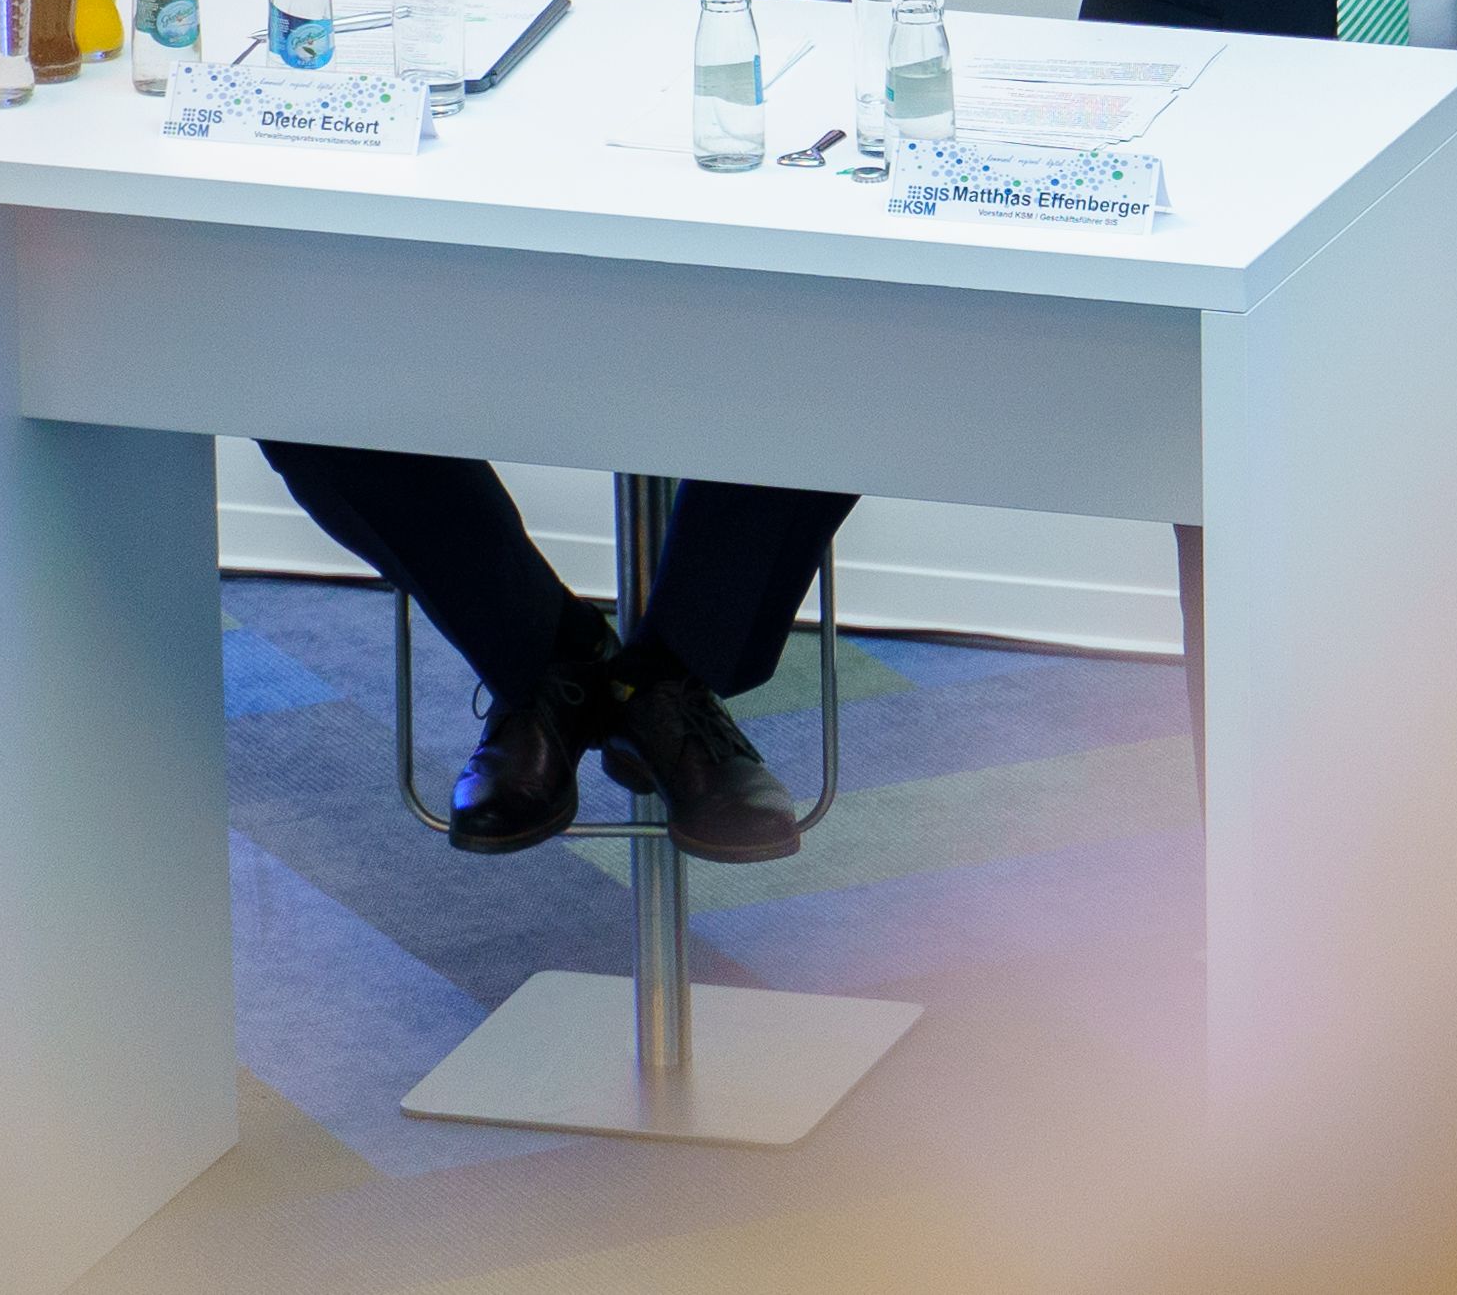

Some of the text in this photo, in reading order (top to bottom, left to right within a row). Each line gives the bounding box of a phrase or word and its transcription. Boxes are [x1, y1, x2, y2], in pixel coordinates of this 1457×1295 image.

[196, 110, 223, 123] SIS
[261, 110, 380, 134] Dieter Eckert
[177, 123, 209, 137] KSM
[922, 187, 950, 202] SIS
[953, 185, 1150, 218] Matthias Effenberger
[902, 200, 936, 216] KSM
[977, 208, 1013, 219] Vorstand
